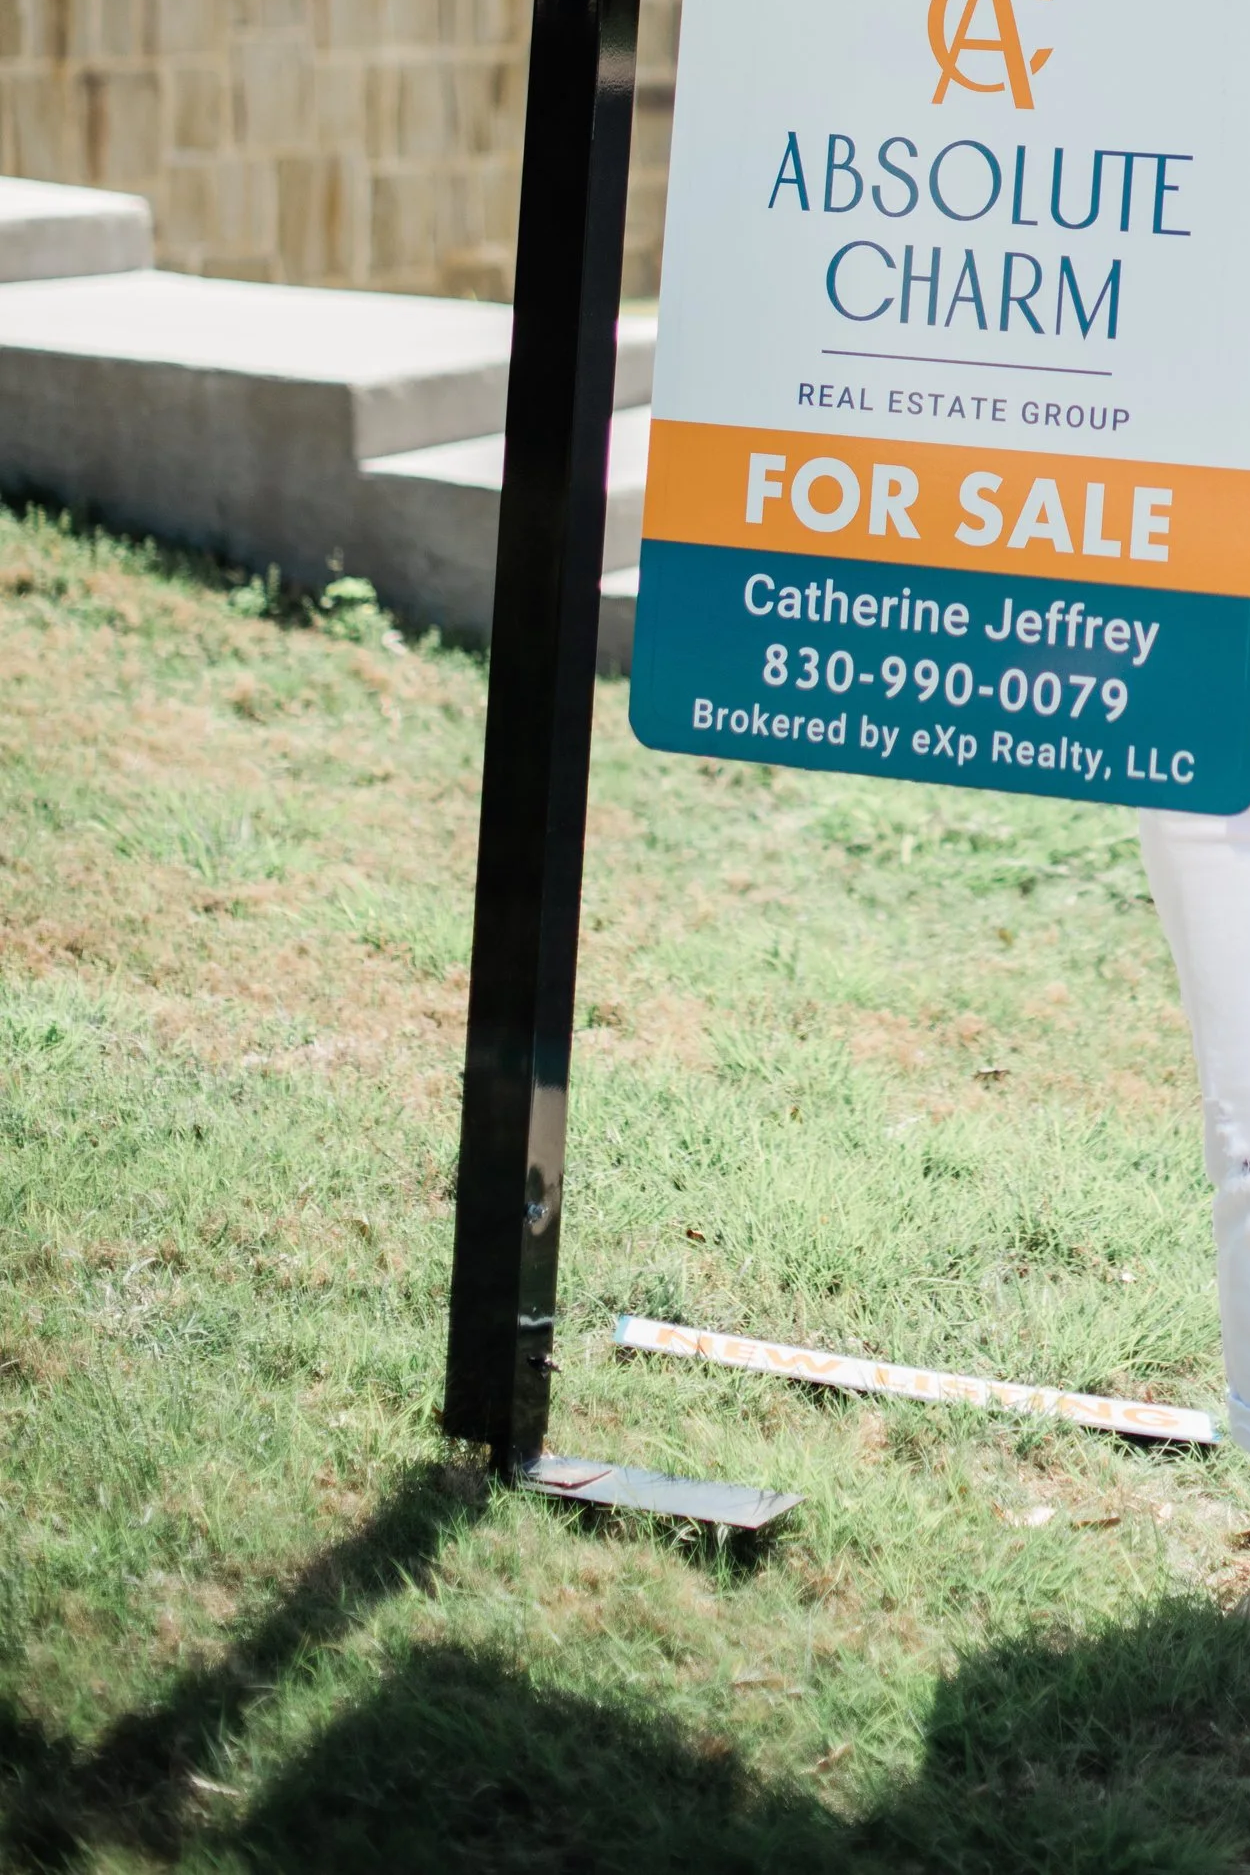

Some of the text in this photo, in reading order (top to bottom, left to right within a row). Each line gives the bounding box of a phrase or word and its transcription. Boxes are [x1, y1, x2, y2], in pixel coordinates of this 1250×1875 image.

[767, 130, 1194, 237] ABSOLUTE
[825, 239, 1122, 340] CHARM
[797, 381, 1132, 432] REAL ESTATE GROUP
[744, 451, 1174, 563] FOR SALE
[743, 572, 1160, 667] Catherine Jeffrey
[761, 643, 1130, 724] 830-990-0079
[692, 697, 1196, 784] Brokered by eXp Realty, LLC
[656, 1327, 844, 1374] NEW
